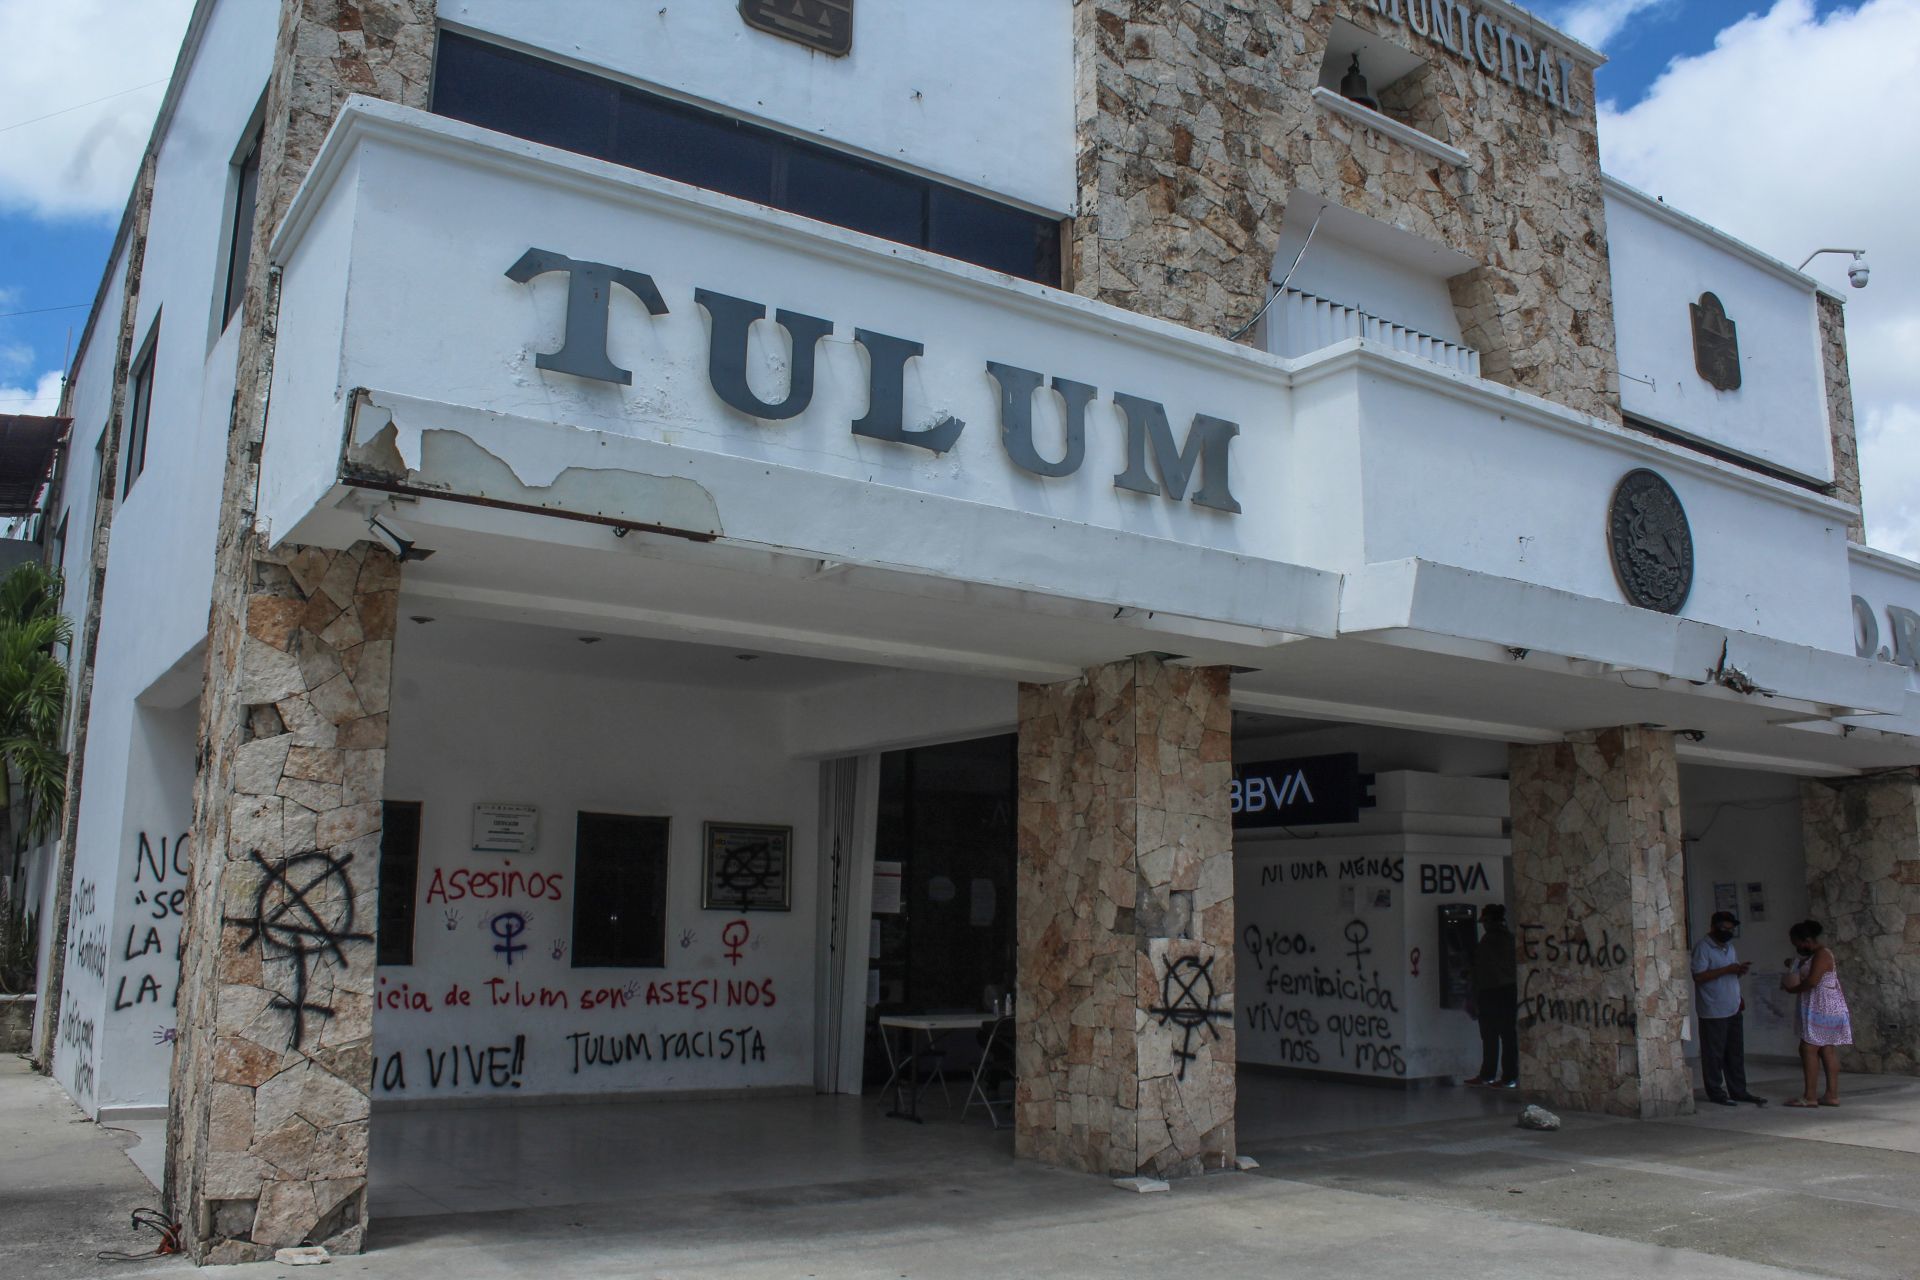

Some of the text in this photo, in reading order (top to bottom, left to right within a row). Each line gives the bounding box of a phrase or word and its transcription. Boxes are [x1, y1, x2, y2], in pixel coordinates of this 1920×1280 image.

[504, 246, 1242, 514] TULUM
[1231, 769, 1314, 812] BBVA
[1261, 856, 1404, 887] NI UNA MENOS
[1420, 861, 1490, 894] BBVA
[125, 924, 162, 961] LA
[1519, 924, 1626, 968] Estado
[114, 973, 162, 1012] LA
[444, 983, 471, 1006] de
[483, 976, 568, 1009] Tulum
[580, 987, 626, 1010] son
[645, 978, 776, 1009] ASESINOS
[566, 1031, 652, 1074] TULUM
[1327, 1014, 1392, 1057] quere
[1280, 1037, 1407, 1075] nos mos
